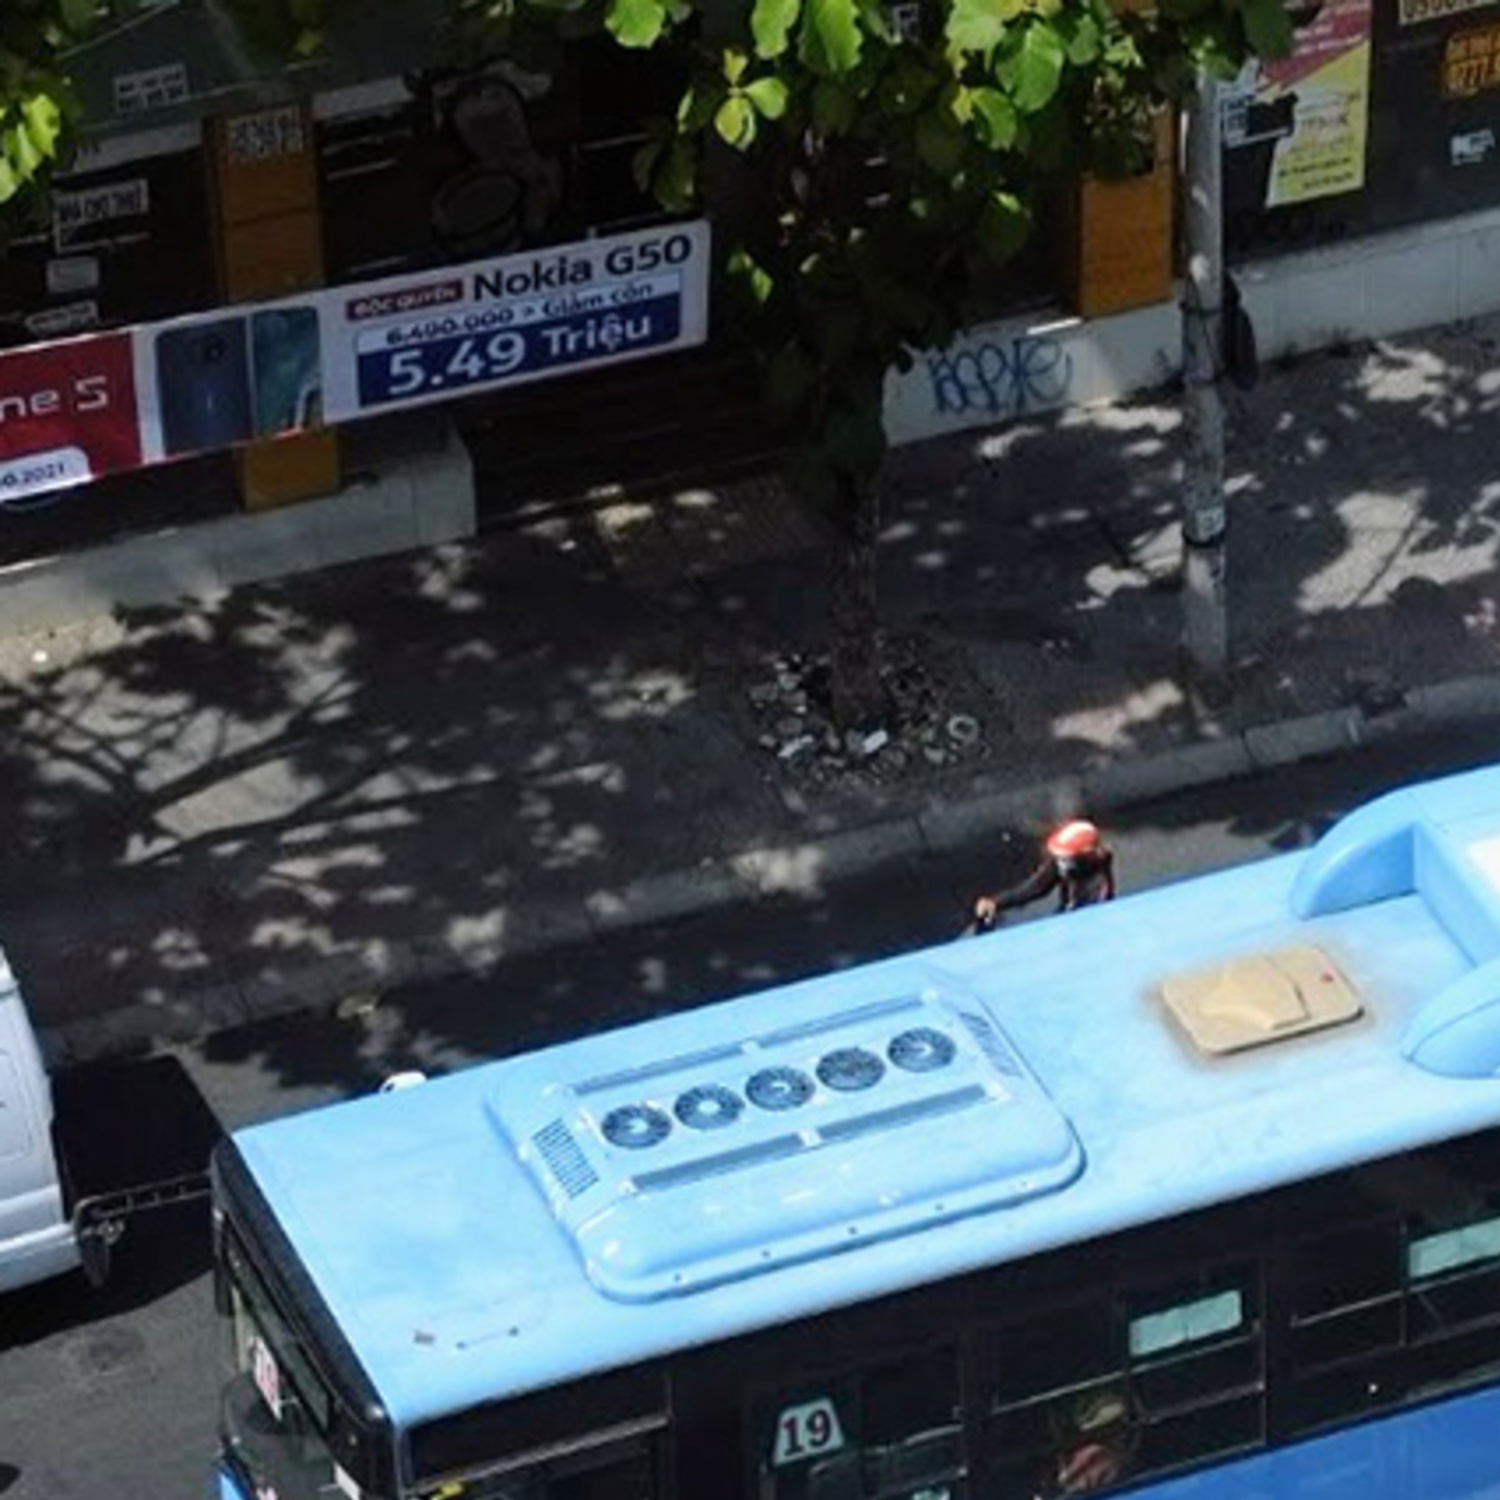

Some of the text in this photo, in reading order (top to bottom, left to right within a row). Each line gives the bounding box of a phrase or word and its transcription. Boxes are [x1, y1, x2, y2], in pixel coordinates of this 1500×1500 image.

[472, 256, 593, 302] Nokia
[605, 234, 692, 276] G50
[388, 313, 651, 395] 5.49 Triệu
[783, 1408, 832, 1456] 19
